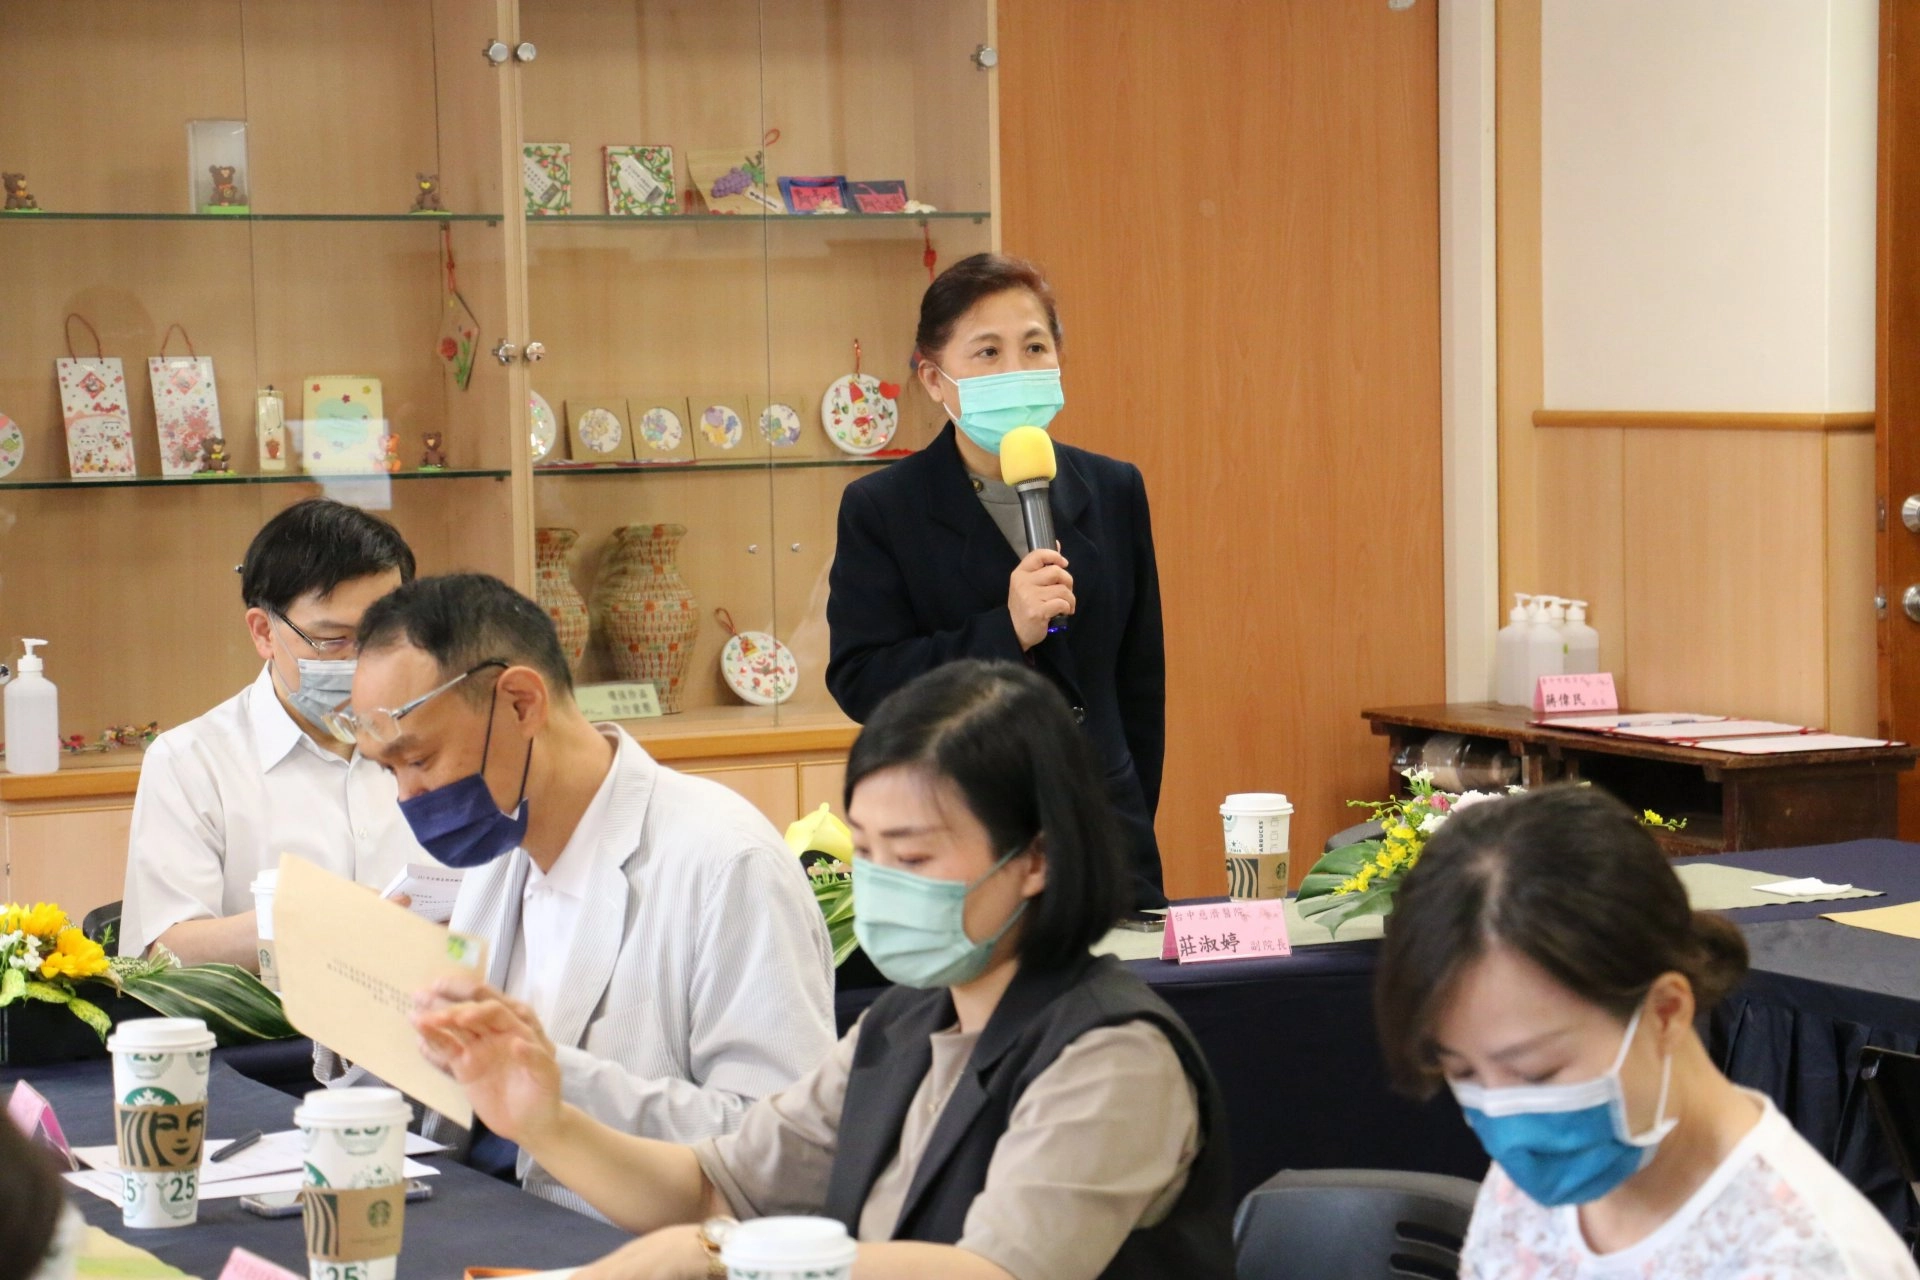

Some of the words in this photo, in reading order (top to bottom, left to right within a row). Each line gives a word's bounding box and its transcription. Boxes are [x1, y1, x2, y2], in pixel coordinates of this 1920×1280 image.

[1179, 932, 1240, 957] 莊淑婷
[1250, 938, 1287, 952] 副院長
[169, 1174, 196, 1203] 25
